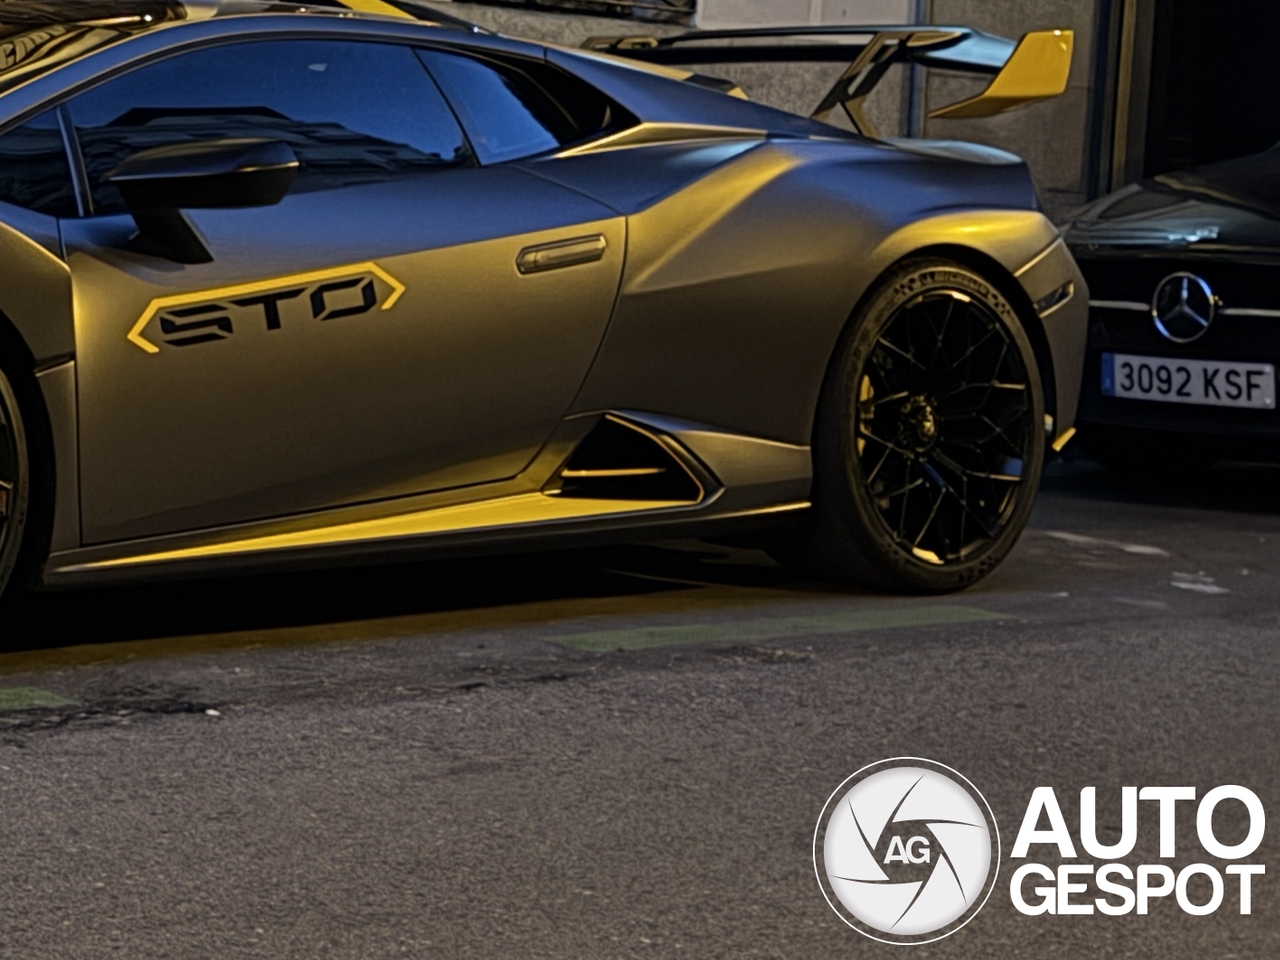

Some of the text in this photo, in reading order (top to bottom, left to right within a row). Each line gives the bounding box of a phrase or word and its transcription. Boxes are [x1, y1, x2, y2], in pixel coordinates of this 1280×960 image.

[159, 277, 377, 347] STO
[1120, 362, 1265, 402] 3092 KSF
